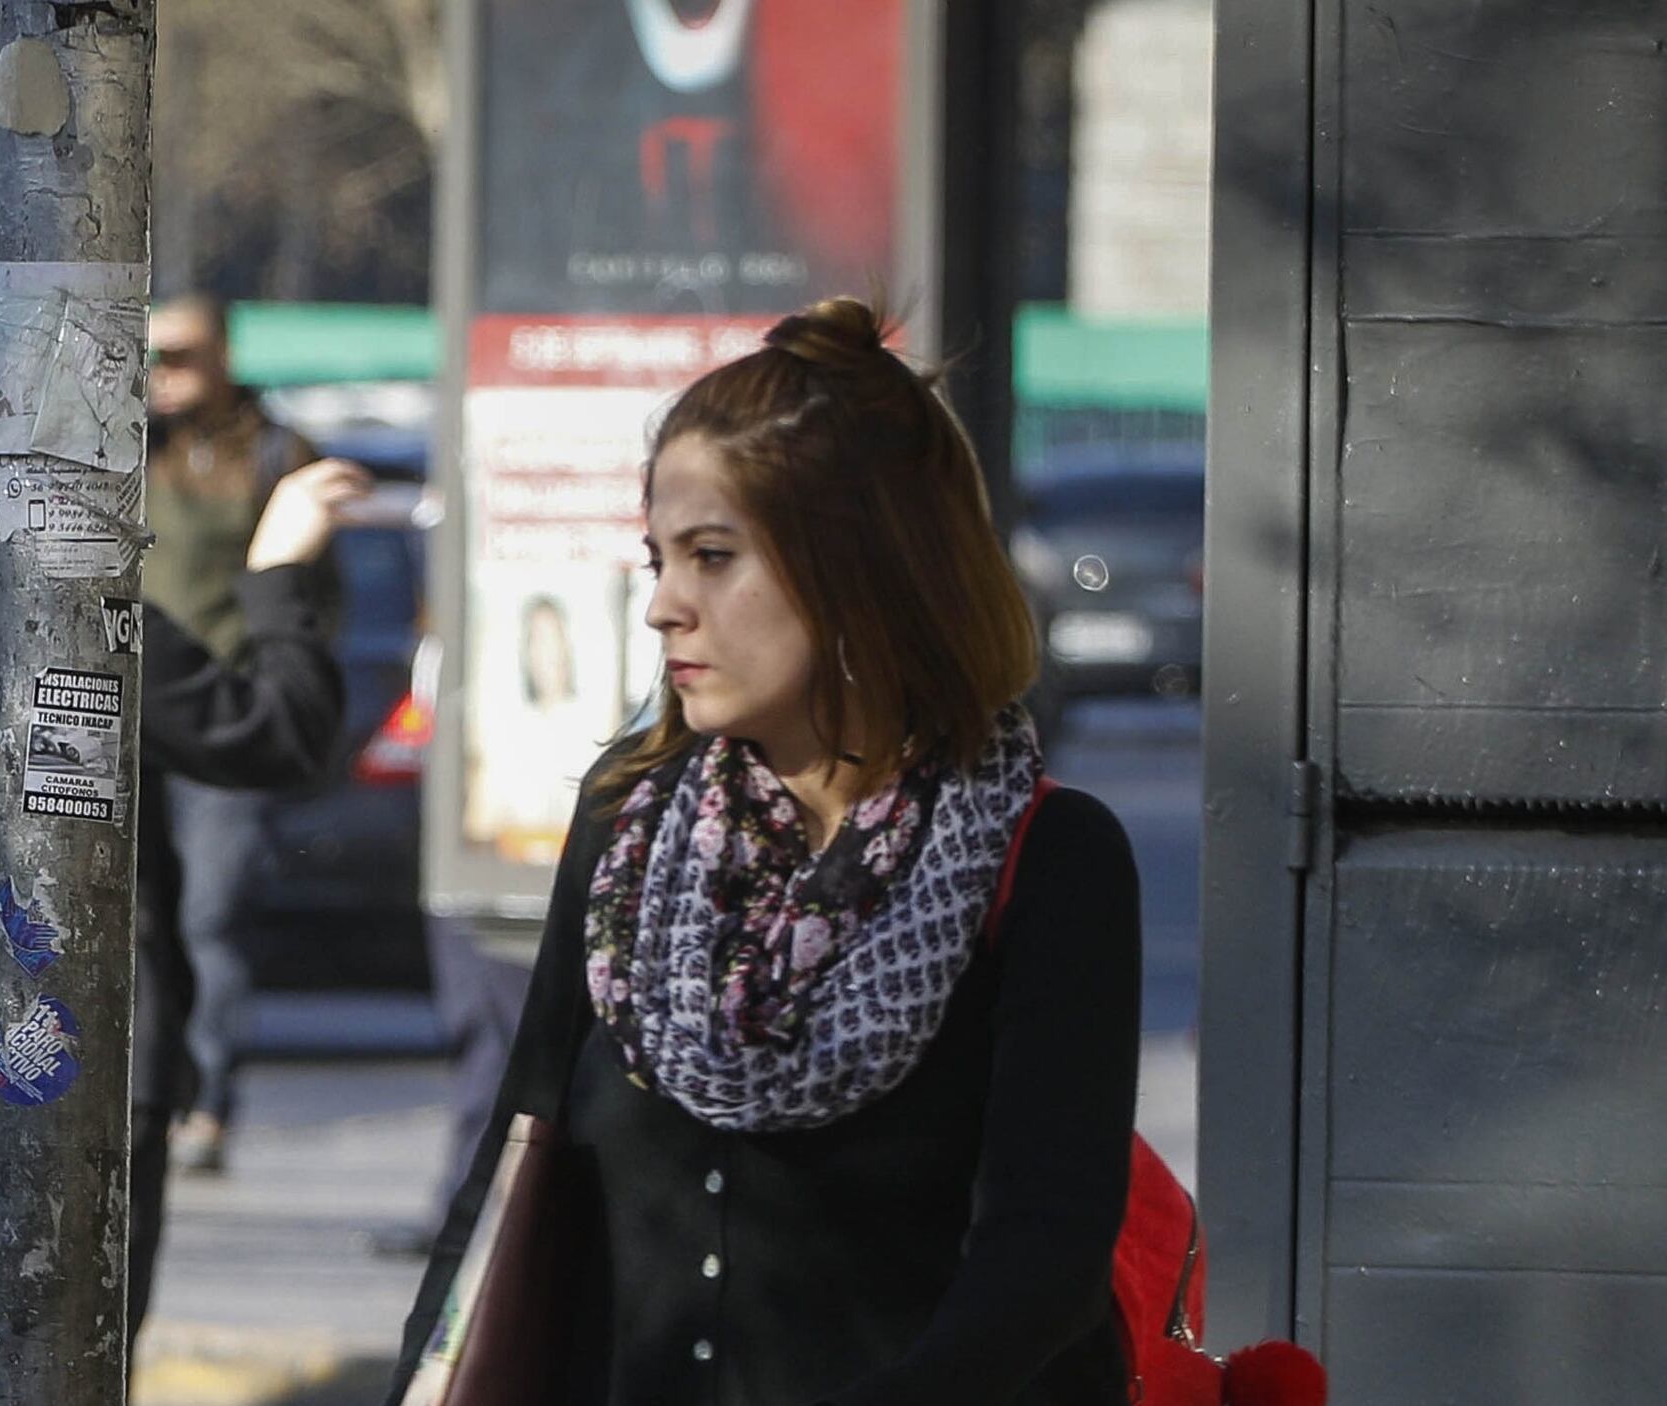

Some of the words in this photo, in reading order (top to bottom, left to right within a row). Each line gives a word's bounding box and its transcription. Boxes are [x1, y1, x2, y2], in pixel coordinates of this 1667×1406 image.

[37, 688, 119, 712] ELECTRICAS
[38, 712, 80, 727] TECNICO
[41, 784, 99, 798] CITOFONOS
[45, 776, 95, 788] CAMARAS
[27, 796, 108, 818] 958400053
[22, 1021, 63, 1054] PARO
